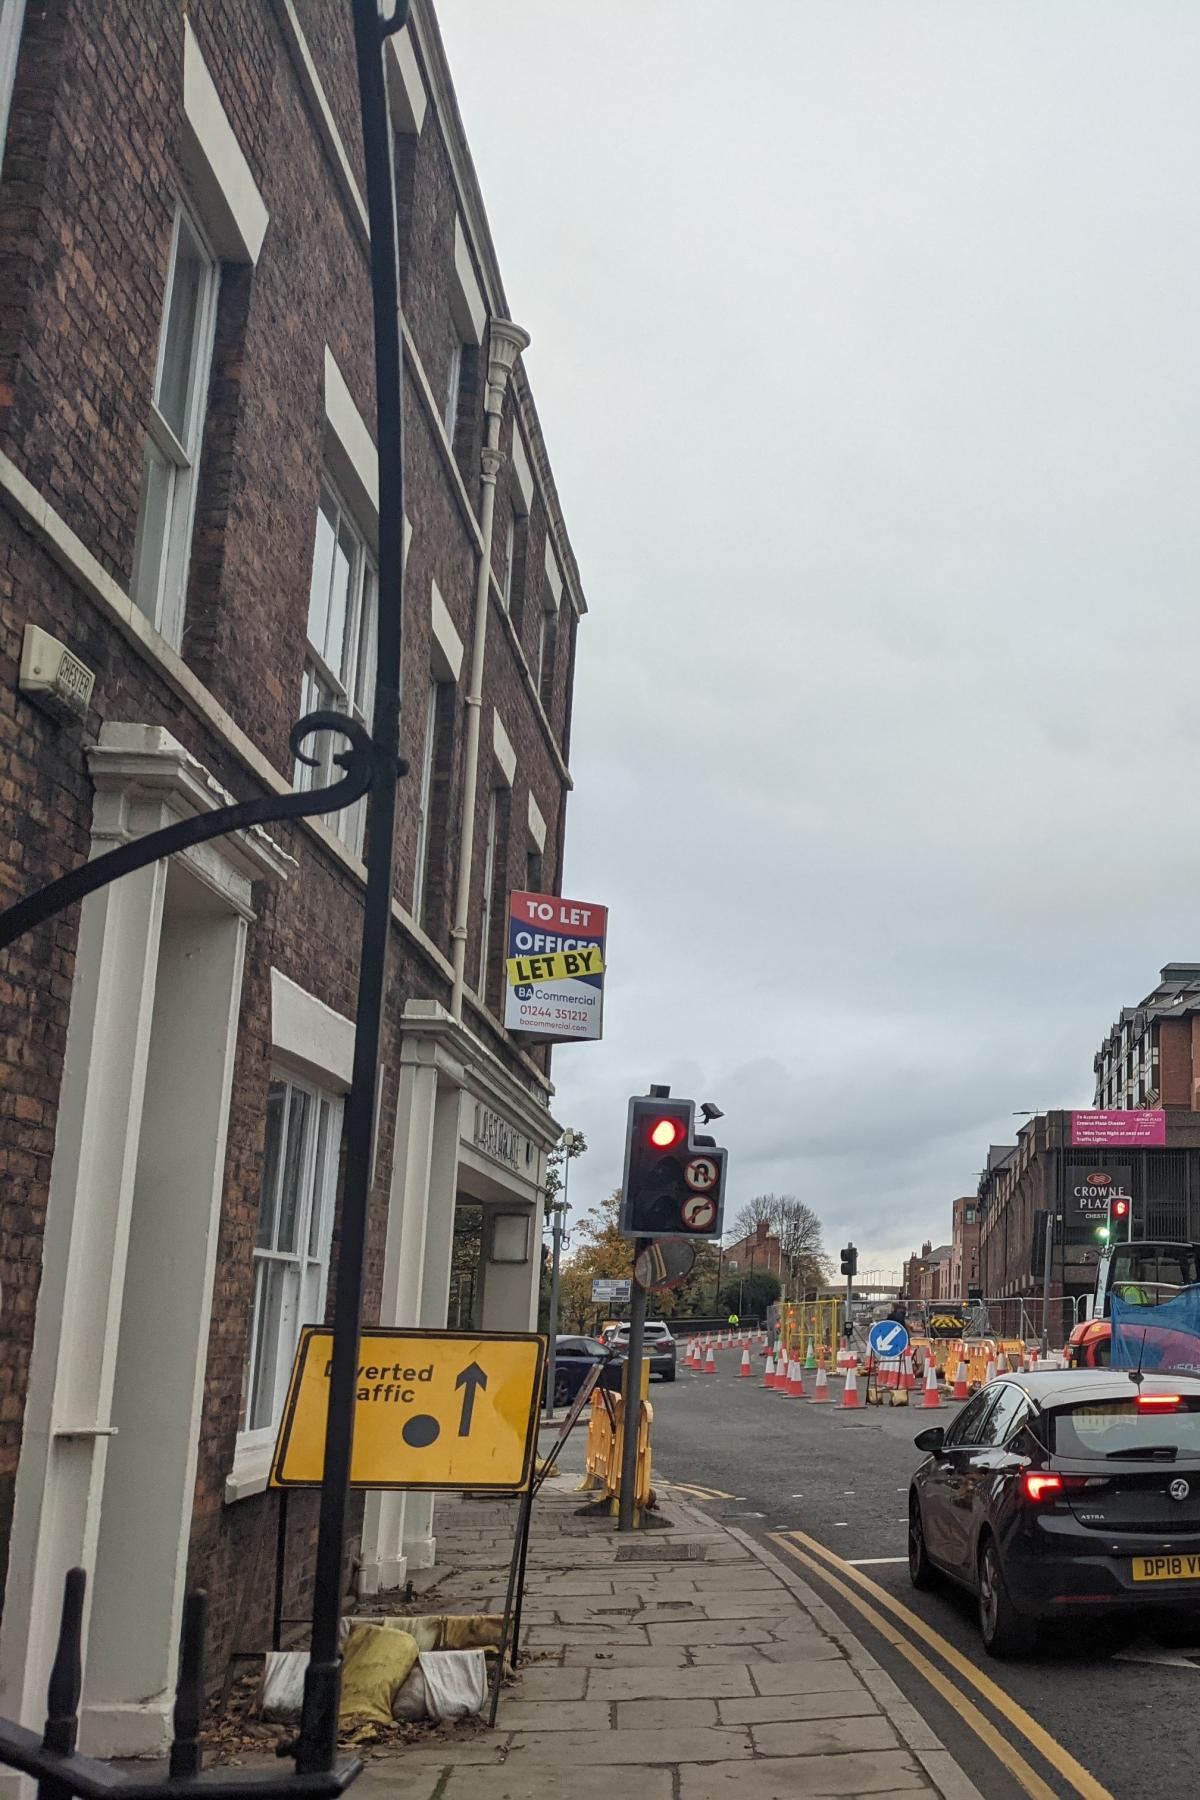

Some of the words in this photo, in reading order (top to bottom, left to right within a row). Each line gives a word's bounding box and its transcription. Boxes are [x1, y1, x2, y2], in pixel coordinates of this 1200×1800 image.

[60, 654, 90, 699] CHESTER
[526, 901, 554, 921] TO
[560, 906, 592, 927] LET
[516, 956, 556, 981] LET
[564, 952, 593, 975] BY
[518, 986, 532, 998] BA
[535, 989, 596, 1006] Commercial
[520, 1004, 551, 1018] 01244
[555, 1008, 588, 1021] 351212
[519, 1017, 588, 1032] bacommercial.com
[1074, 1186, 1124, 1197] CROWNE
[1080, 1198, 1110, 1209] PLAZ
[356, 1384, 415, 1403] affic
[1144, 1557, 1182, 1577] DP18
